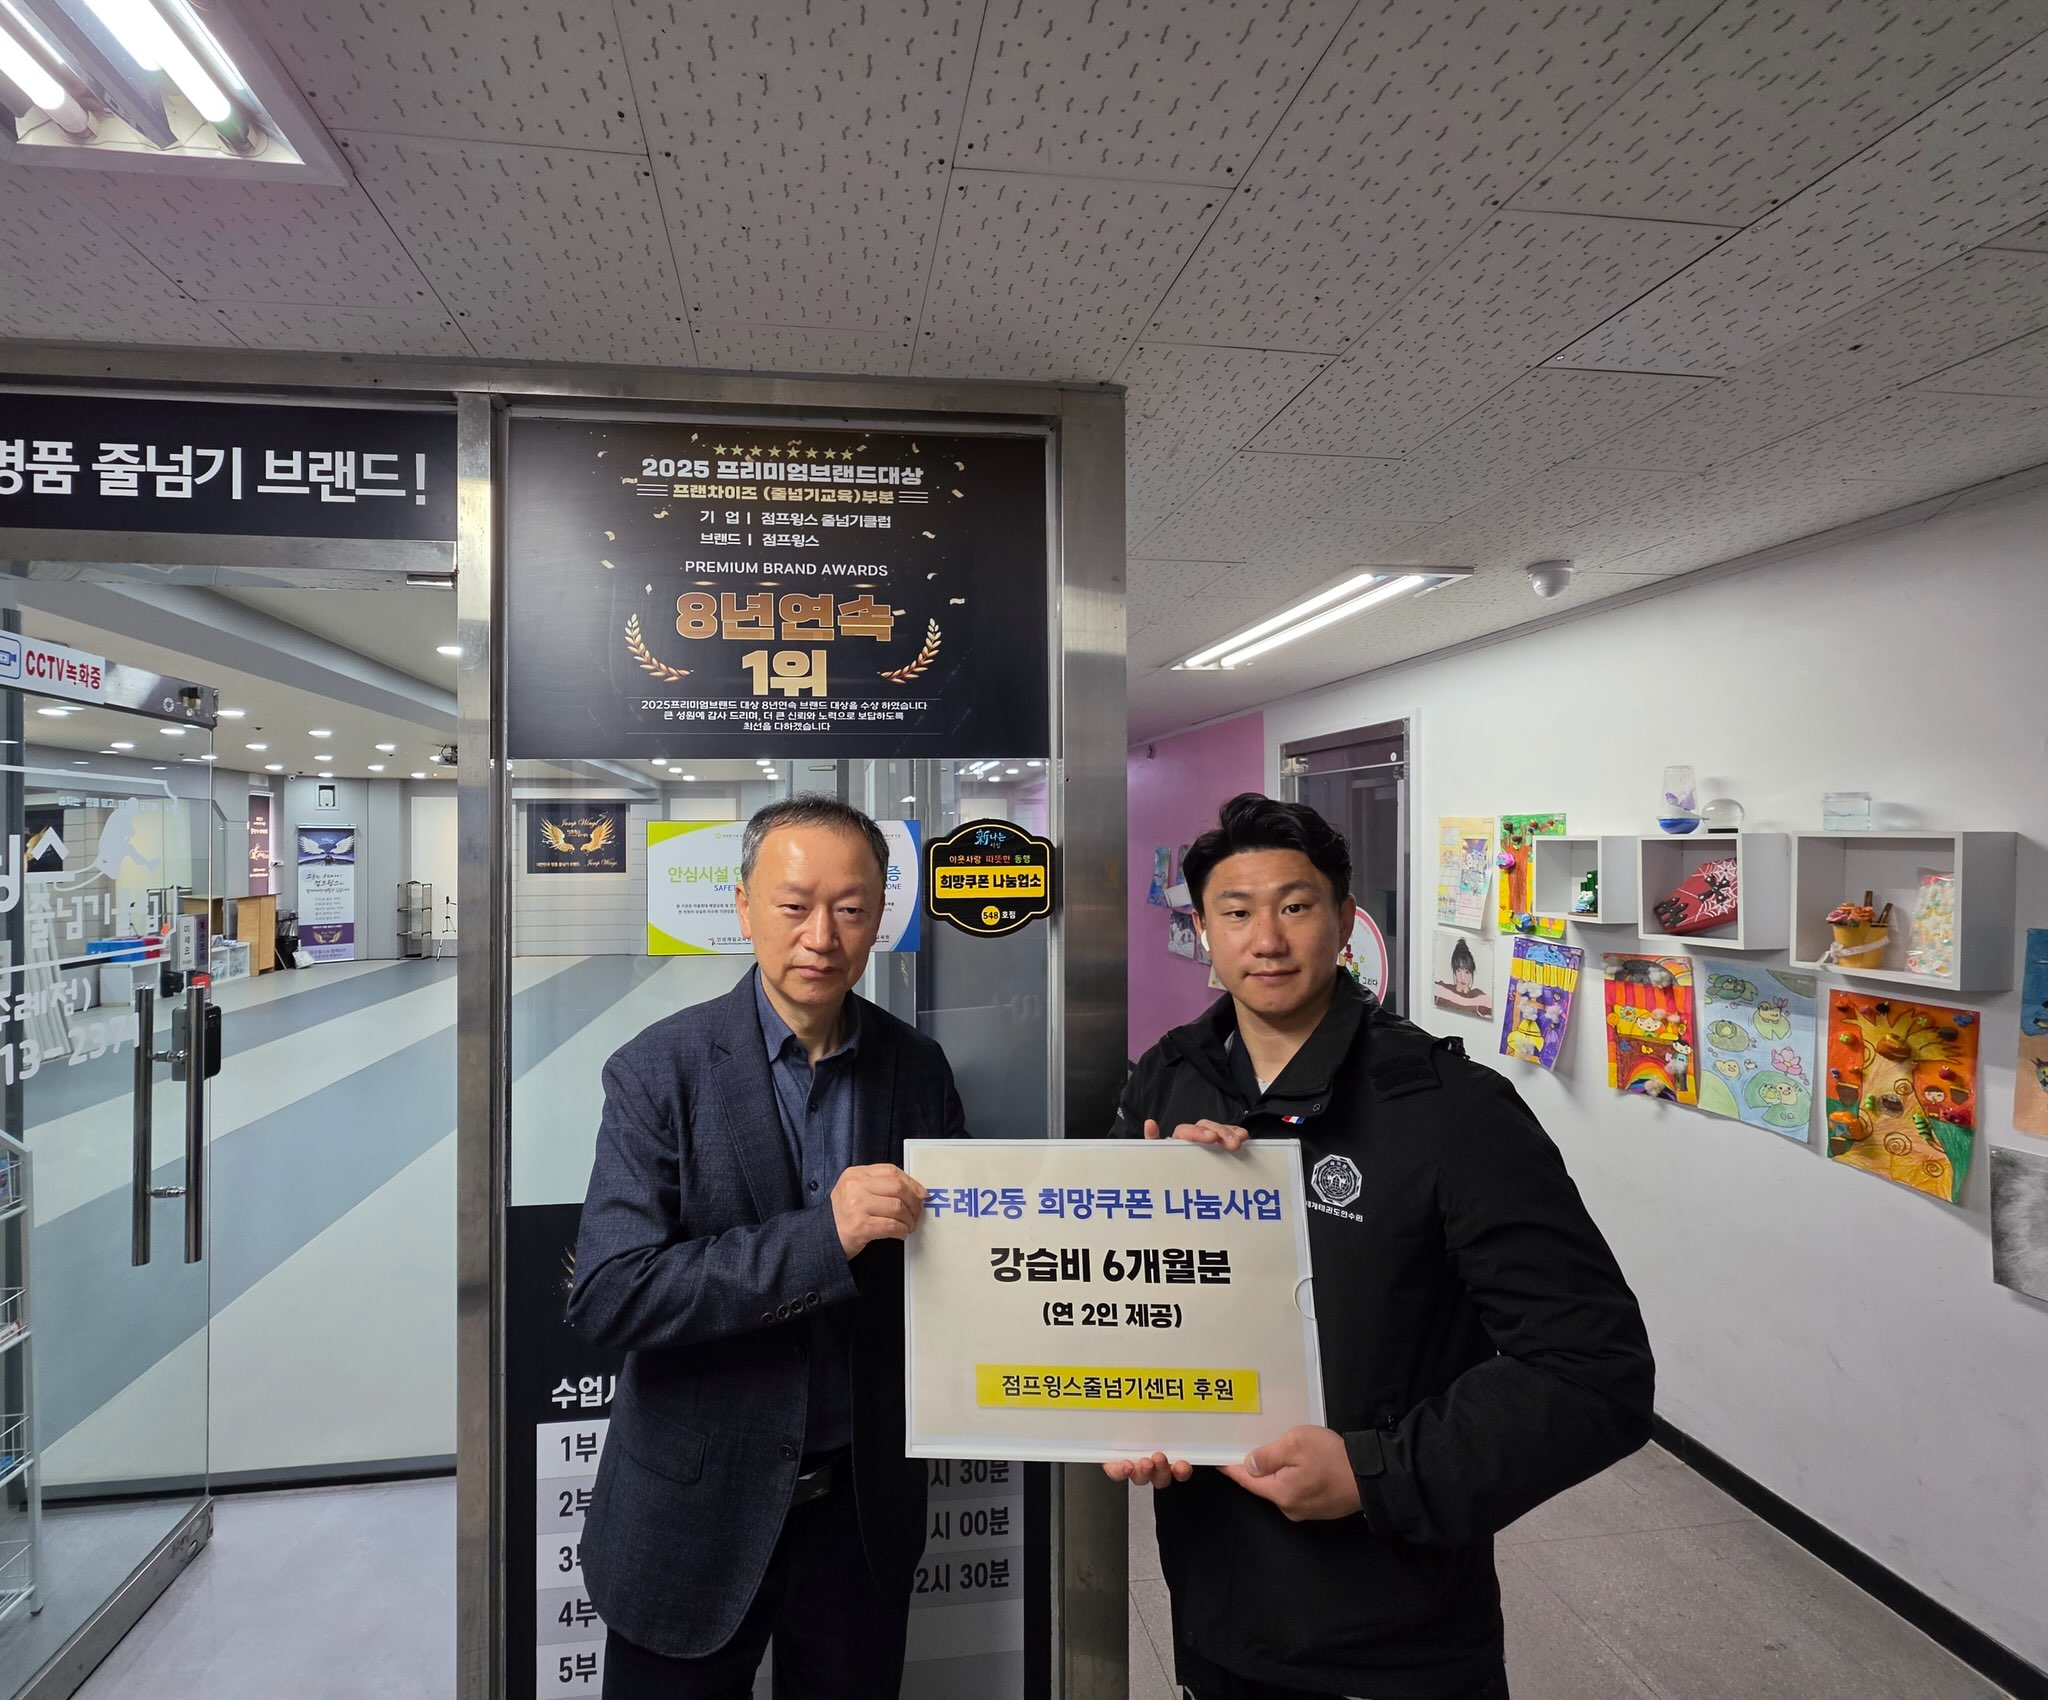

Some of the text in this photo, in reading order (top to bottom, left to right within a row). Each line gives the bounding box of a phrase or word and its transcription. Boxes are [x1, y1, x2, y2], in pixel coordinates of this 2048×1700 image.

[0, 439, 79, 495] 명품
[92, 443, 242, 500] 줄넘기
[641, 458, 924, 486] 2025 프리미엄브랜드대상
[673, 483, 895, 505] 프랜차이즈 (줄넘기교육)부분
[761, 511, 818, 527] 점프윙스
[821, 512, 891, 529] 줄넘기클럽
[700, 532, 819, 547] 브랜드 점프윙스
[685, 561, 888, 576] PREMIUM BRAND AWARDS
[675, 591, 893, 641] 8년연속
[741, 650, 828, 697] 1위
[664, 711, 904, 721] 큰 성원에 감사 드리며, 더 큰 신뢰와 노력으로 보답하도록
[741, 701, 759, 710] 대상
[762, 701, 797, 710] 8년연속
[799, 701, 828, 710] 브랜드
[830, 701, 857, 710] 대상을
[860, 701, 879, 710] 수상
[743, 722, 830, 731] 최선을 다하겠습니다
[949, 854, 1031, 864] 이웃사랑 따뜻한 동행
[667, 866, 729, 883] 안심시설
[940, 874, 1042, 889] 희망쿠폰 나눔업소
[983, 911, 1016, 920] 548 호점
[923, 1187, 1283, 1222] 주례2동 희망쿠폰 나눔사업
[989, 1247, 1232, 1286] 강습비 6개월분
[1042, 1301, 1183, 1329] (연 2인 제공)
[1001, 1374, 1235, 1401] 점프윙스줄넘기센터 후원
[560, 1432, 598, 1463] 1부
[959, 1460, 1009, 1484] 30분
[959, 1506, 1009, 1536] 00분
[558, 1544, 582, 1574] 3
[959, 1558, 1009, 1589] 30분
[558, 1597, 598, 1629] 4부
[558, 1651, 598, 1684] 5부
